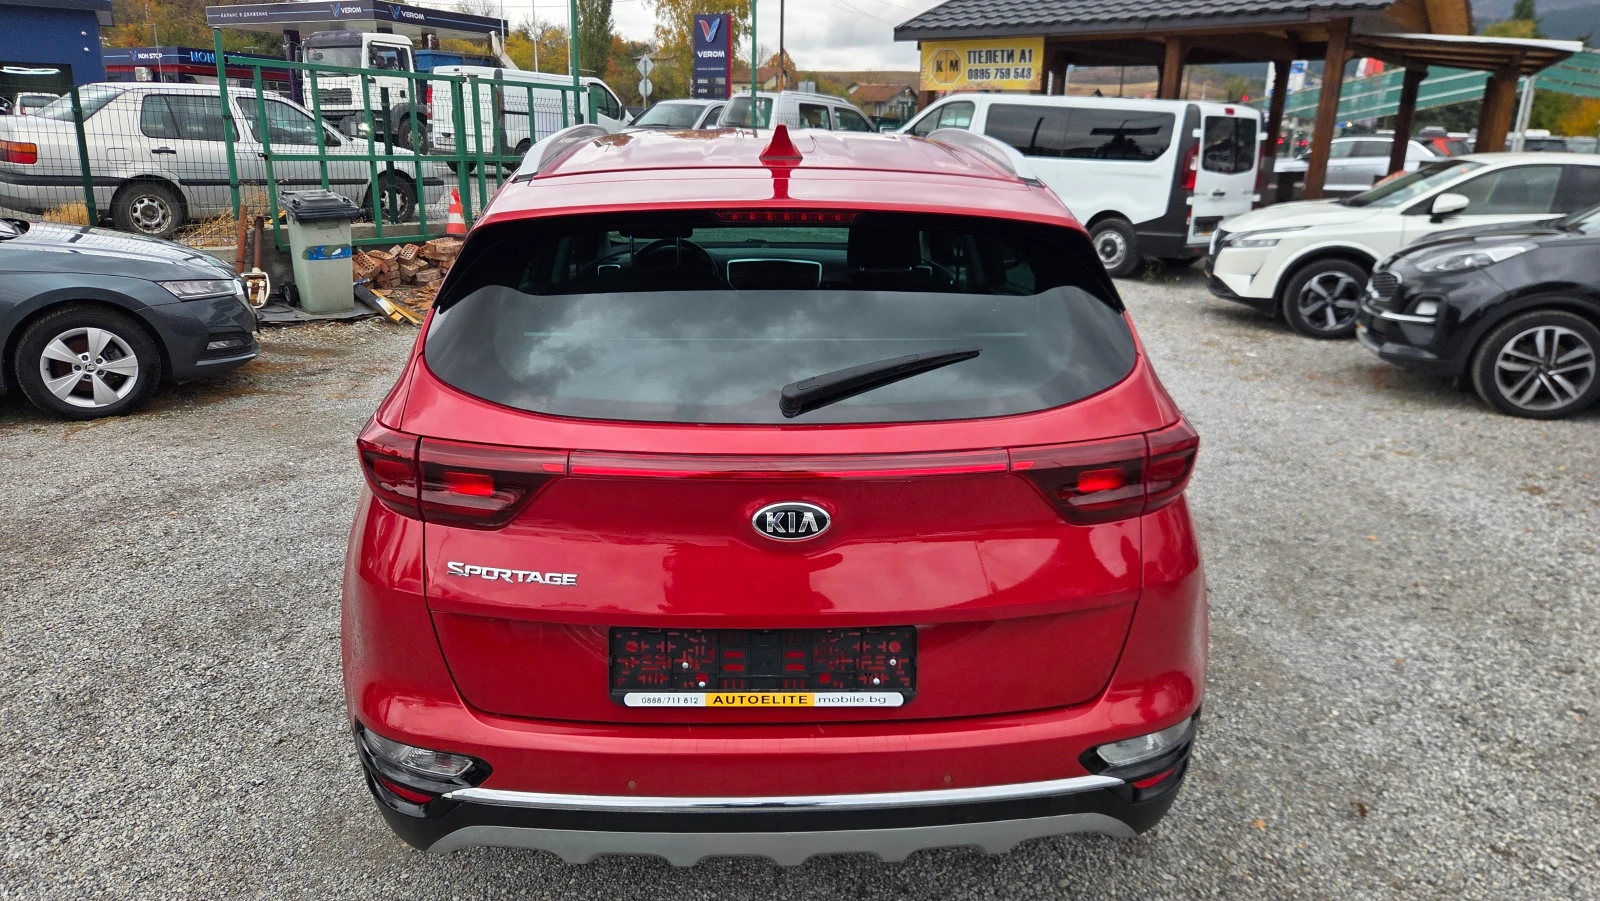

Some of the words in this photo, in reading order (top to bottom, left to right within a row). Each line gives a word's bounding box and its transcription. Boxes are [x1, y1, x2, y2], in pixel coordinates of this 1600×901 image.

[400, 10, 425, 20] VEROM
[697, 50, 725, 58] VEROM
[967, 49, 1015, 64] ПЕЛЕТИ
[967, 68, 991, 79] 0895
[765, 511, 819, 533] KIA
[446, 561, 578, 586] SPORTAGE
[641, 696, 680, 705] 0888/711
[683, 696, 699, 704] 812
[713, 695, 808, 705] AUTOELITE
